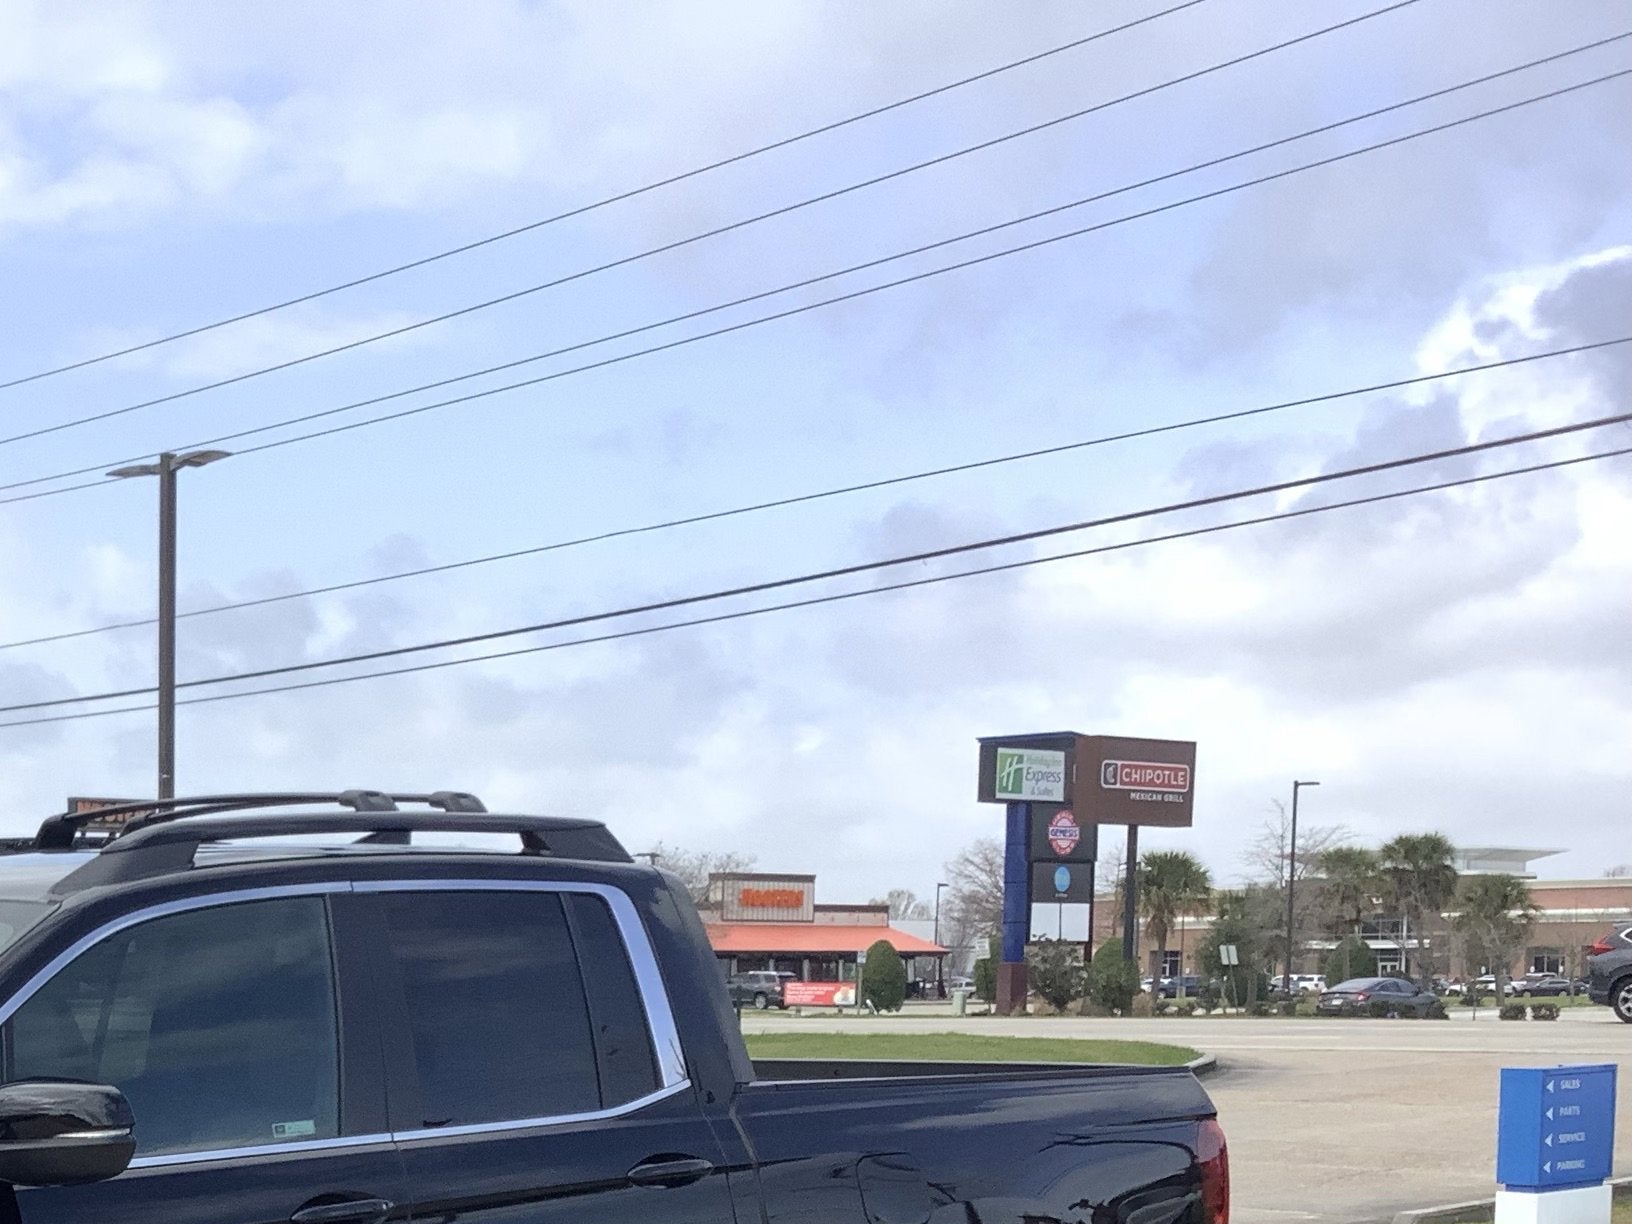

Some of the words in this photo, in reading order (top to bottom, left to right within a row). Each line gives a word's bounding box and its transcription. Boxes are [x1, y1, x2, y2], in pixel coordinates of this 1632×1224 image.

[1025, 767, 1061, 785] Express
[1122, 768, 1185, 785] CHIPOTLE
[1130, 792, 1163, 801] MEXICAN
[1560, 1079, 1581, 1090] SALES
[1559, 1106, 1581, 1116] PARTS
